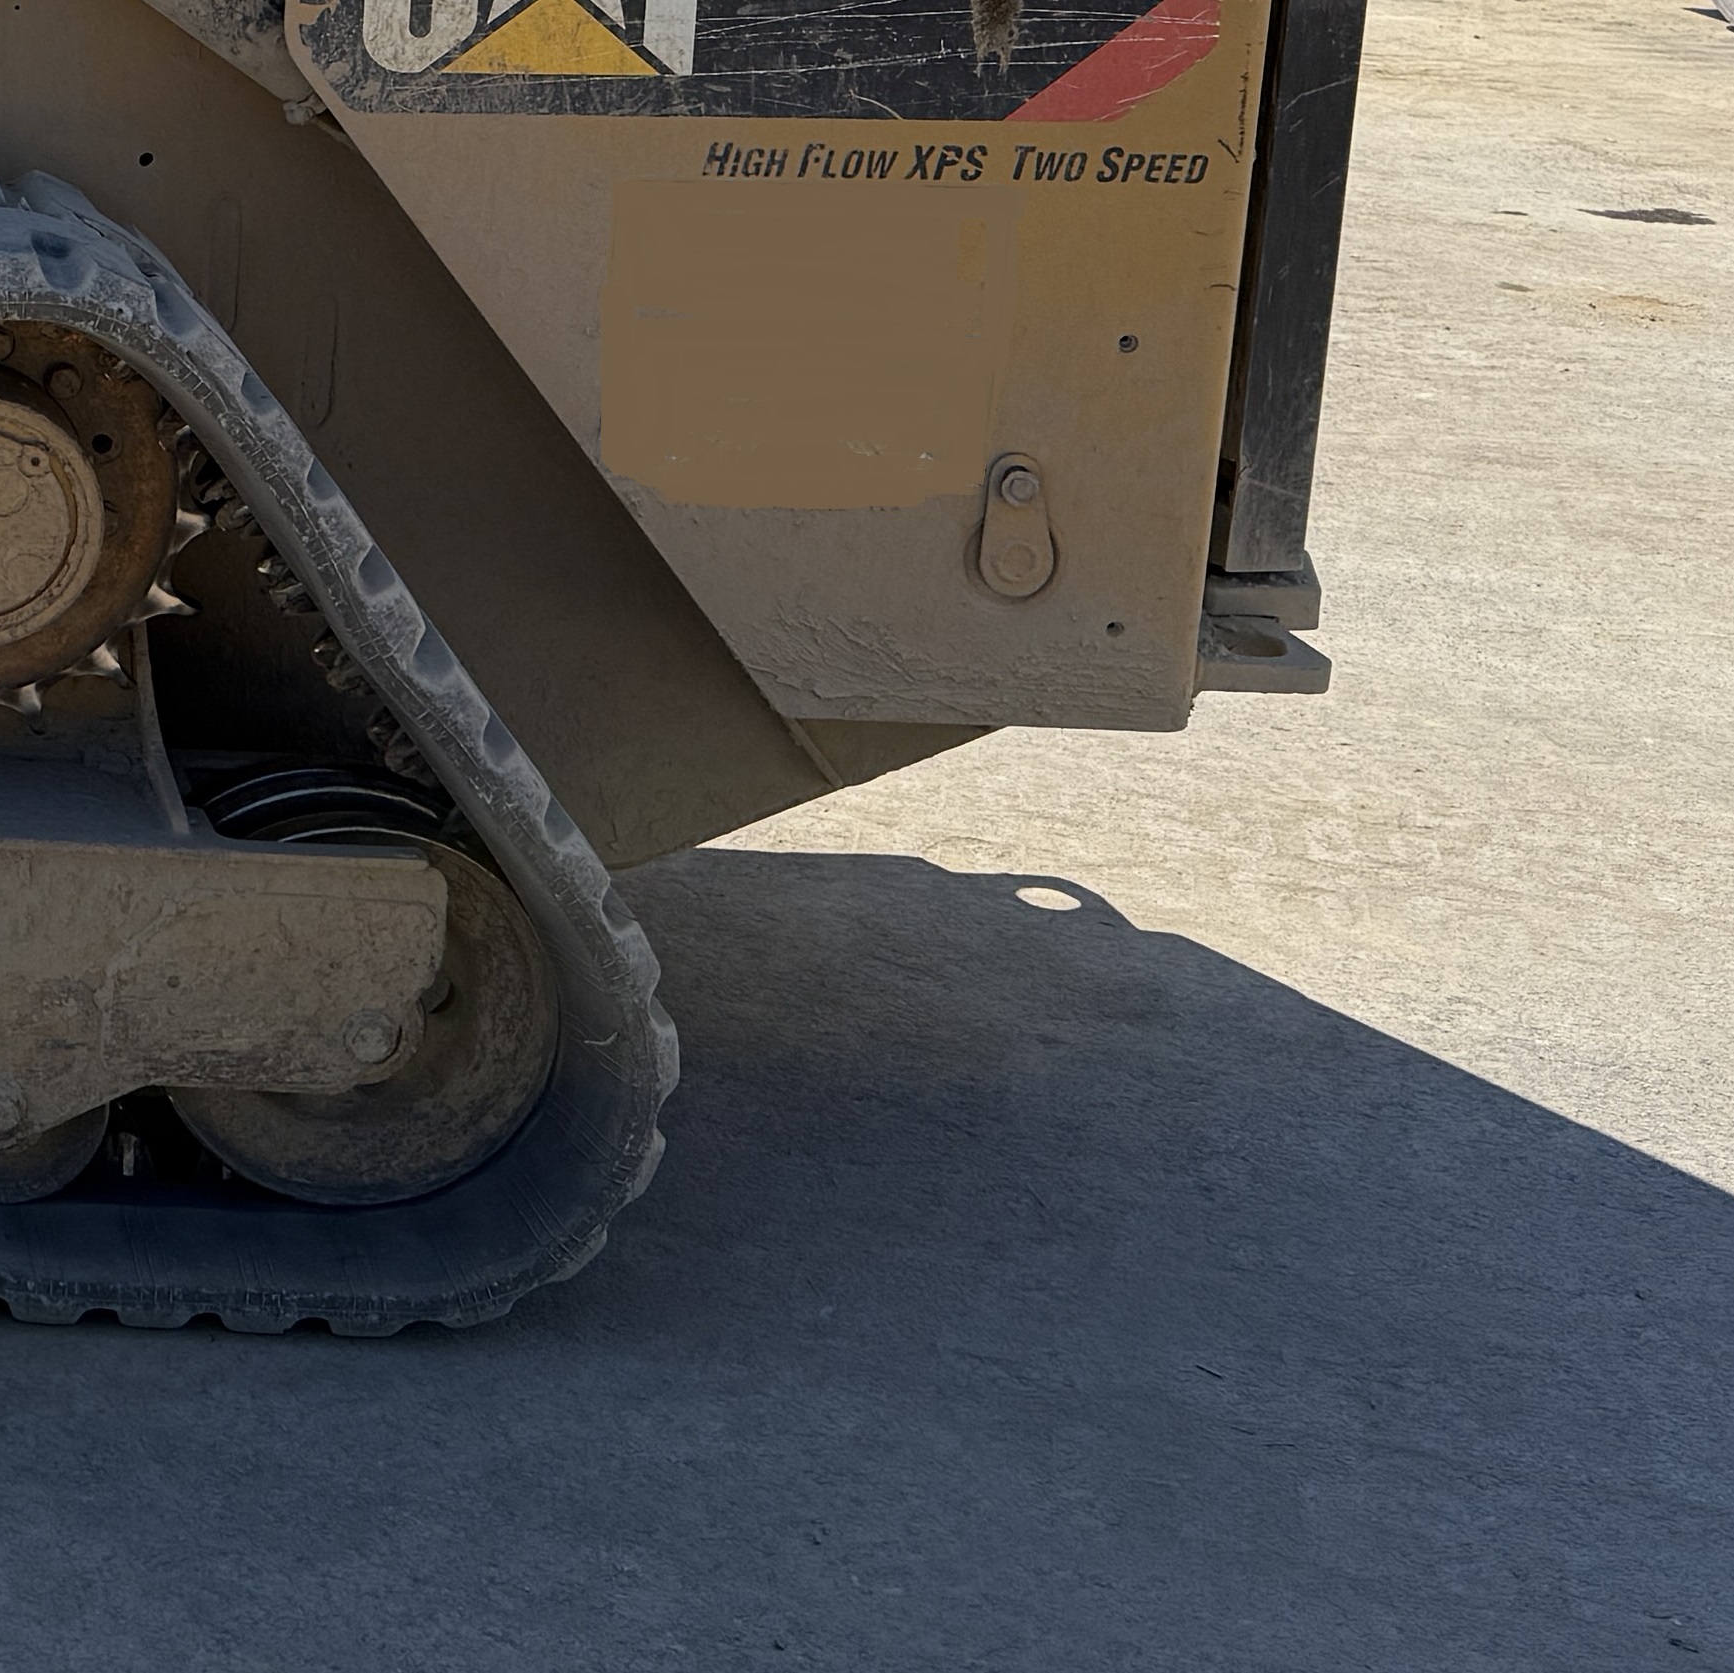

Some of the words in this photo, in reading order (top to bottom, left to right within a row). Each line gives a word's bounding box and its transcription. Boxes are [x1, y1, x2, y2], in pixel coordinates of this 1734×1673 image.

[905, 144, 987, 181] XPS
[1012, 145, 1089, 182] TWO
[1096, 147, 1210, 185] SPEED
